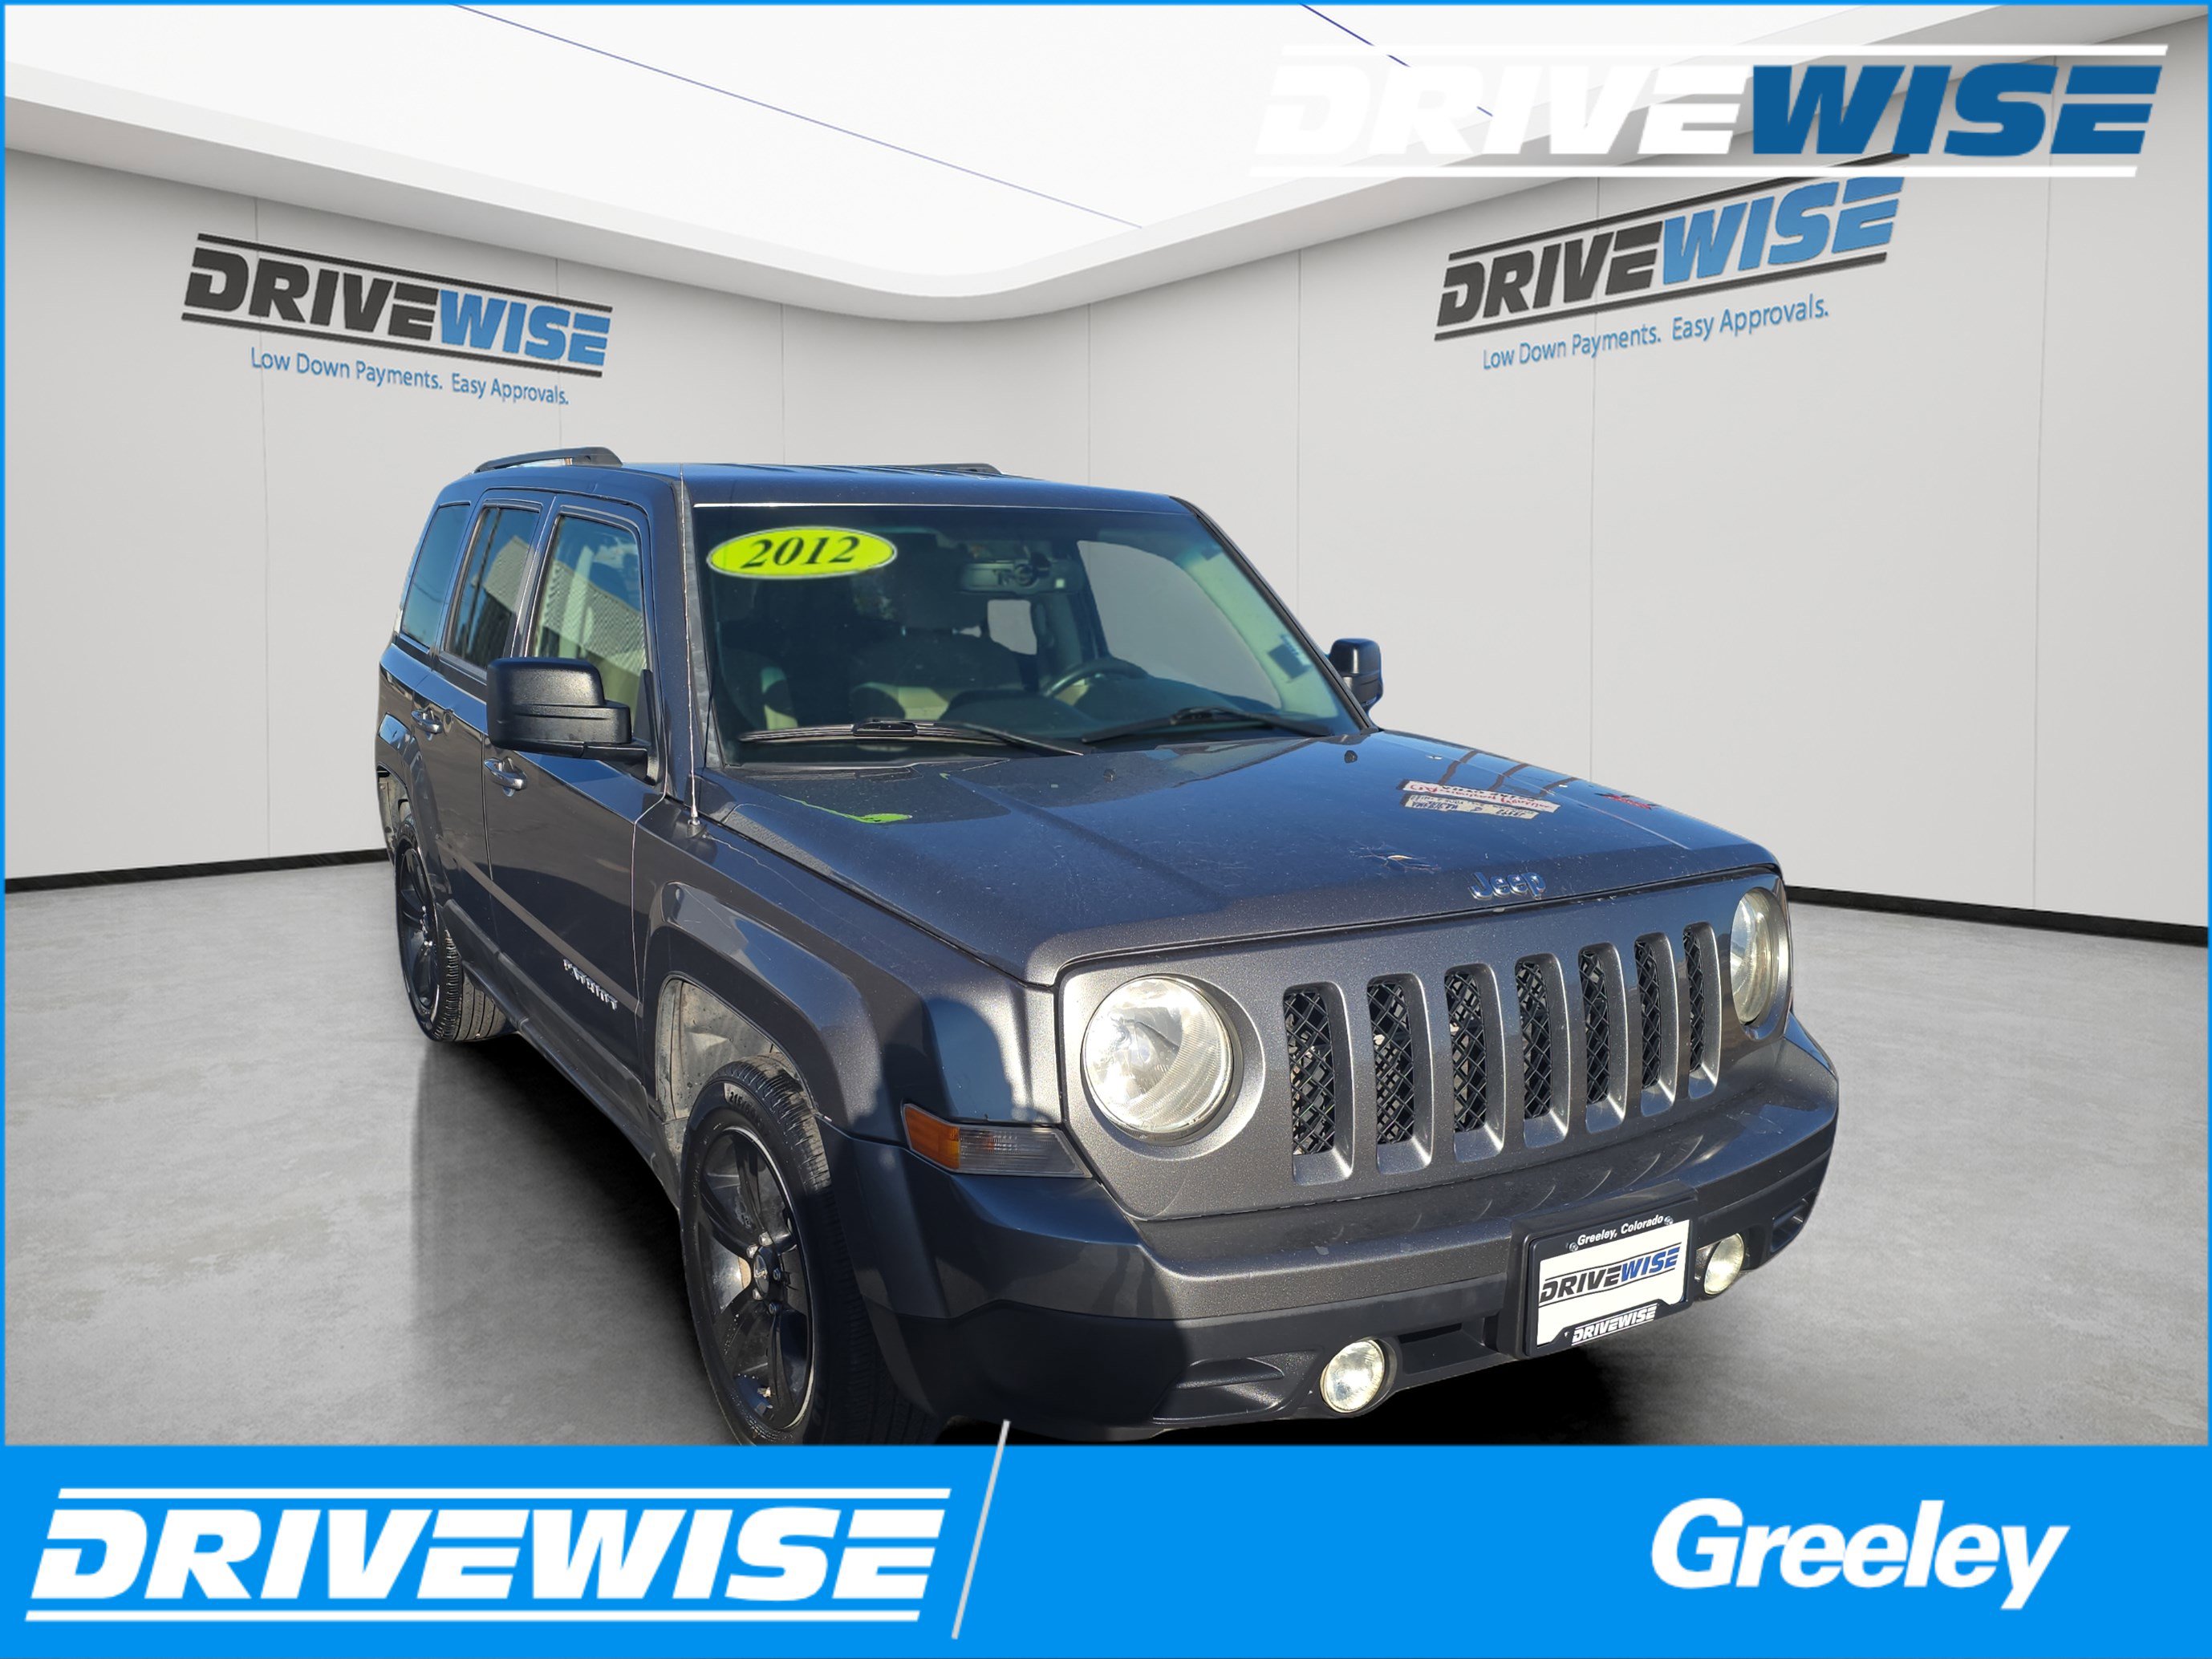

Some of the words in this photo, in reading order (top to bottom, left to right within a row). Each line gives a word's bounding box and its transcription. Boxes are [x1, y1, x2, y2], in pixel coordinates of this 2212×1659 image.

[1437, 176, 1905, 327] DRIVEWISE
[185, 247, 611, 367] DRIVEWISE
[1483, 343, 1514, 369] Low
[1519, 335, 1566, 364] Down
[1572, 325, 1662, 358] Payments.
[1672, 317, 1714, 342] Easy
[1719, 294, 1828, 335] Approvals.
[251, 347, 291, 371] Low
[296, 353, 350, 379] Down
[355, 359, 444, 391] Payments.
[452, 373, 486, 398] Easy
[490, 377, 569, 405] Approvals.
[741, 536, 860, 569] 2012
[1467, 871, 1546, 900] Jeep
[1577, 1229, 1617, 1246] Greeley,
[1621, 1215, 1664, 1234] Colorado
[1540, 1247, 1680, 1303] DRIVEWISE
[1572, 1306, 1656, 1343] DRIVEWISE
